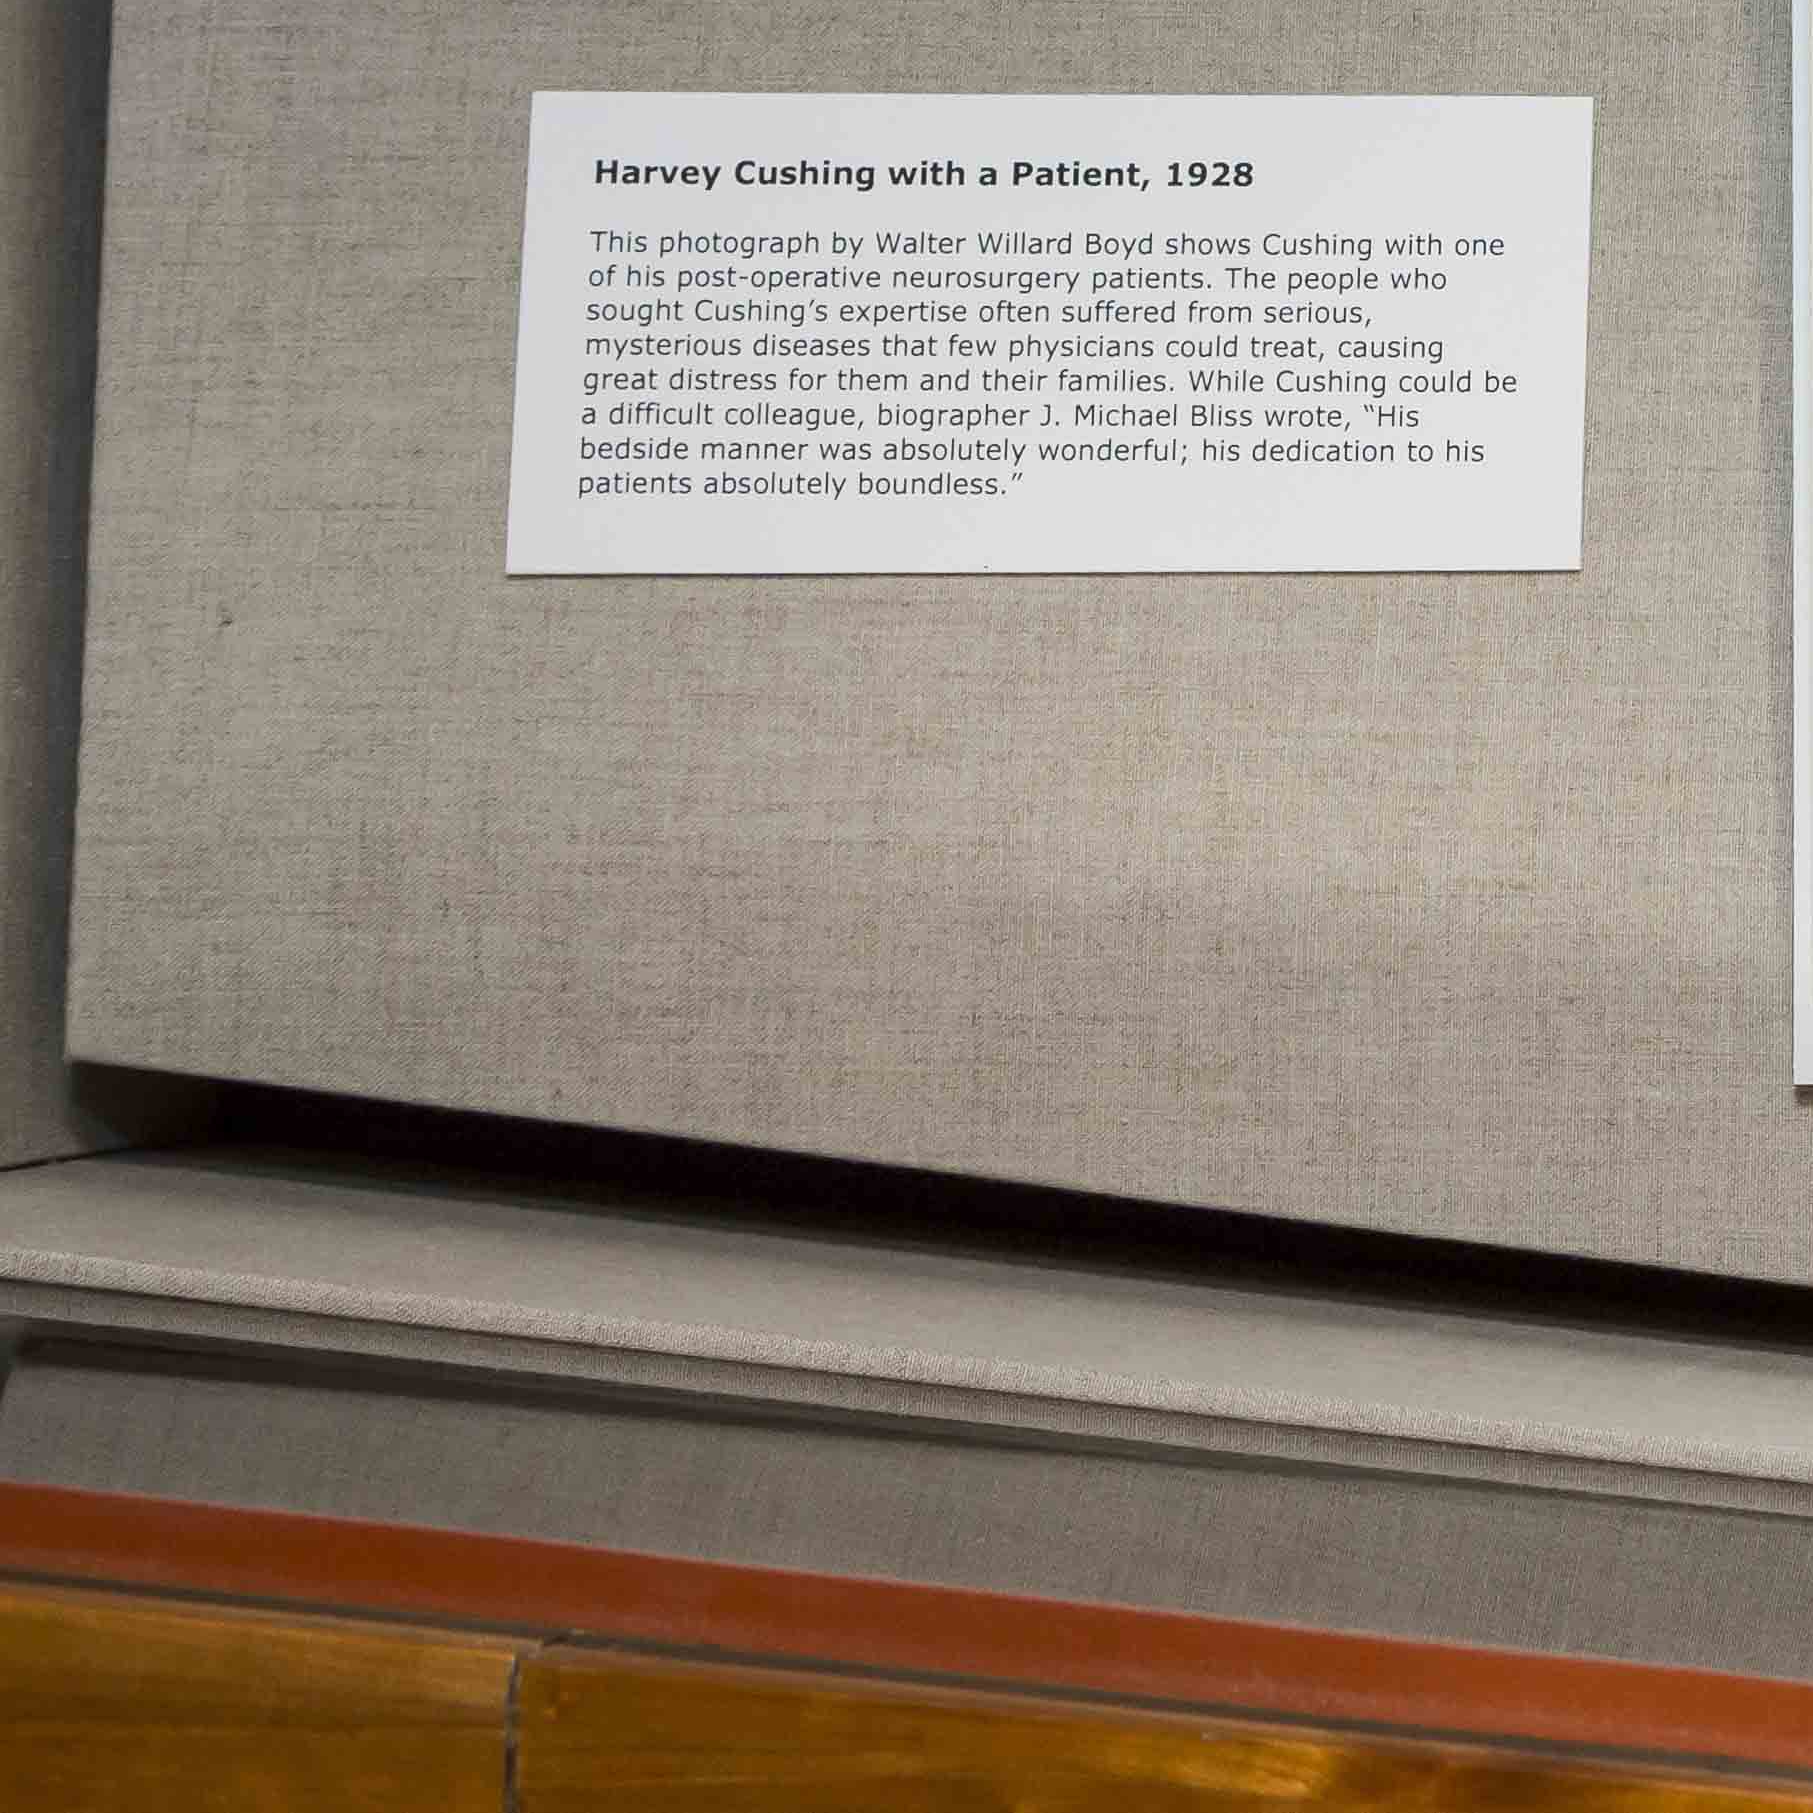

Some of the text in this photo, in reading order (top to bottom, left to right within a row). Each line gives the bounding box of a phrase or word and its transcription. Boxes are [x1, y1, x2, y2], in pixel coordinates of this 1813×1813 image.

[594, 158, 1254, 193] Harvey Cushing with a Patient, 1928
[589, 229, 1505, 262] This photograph by Walter Willard Boyd shows Cushing with one
[588, 263, 1447, 296] of his post-operative neurosurgery patients. The people who
[585, 332, 1443, 365] mysterious diseases that few physicians could treat, causing
